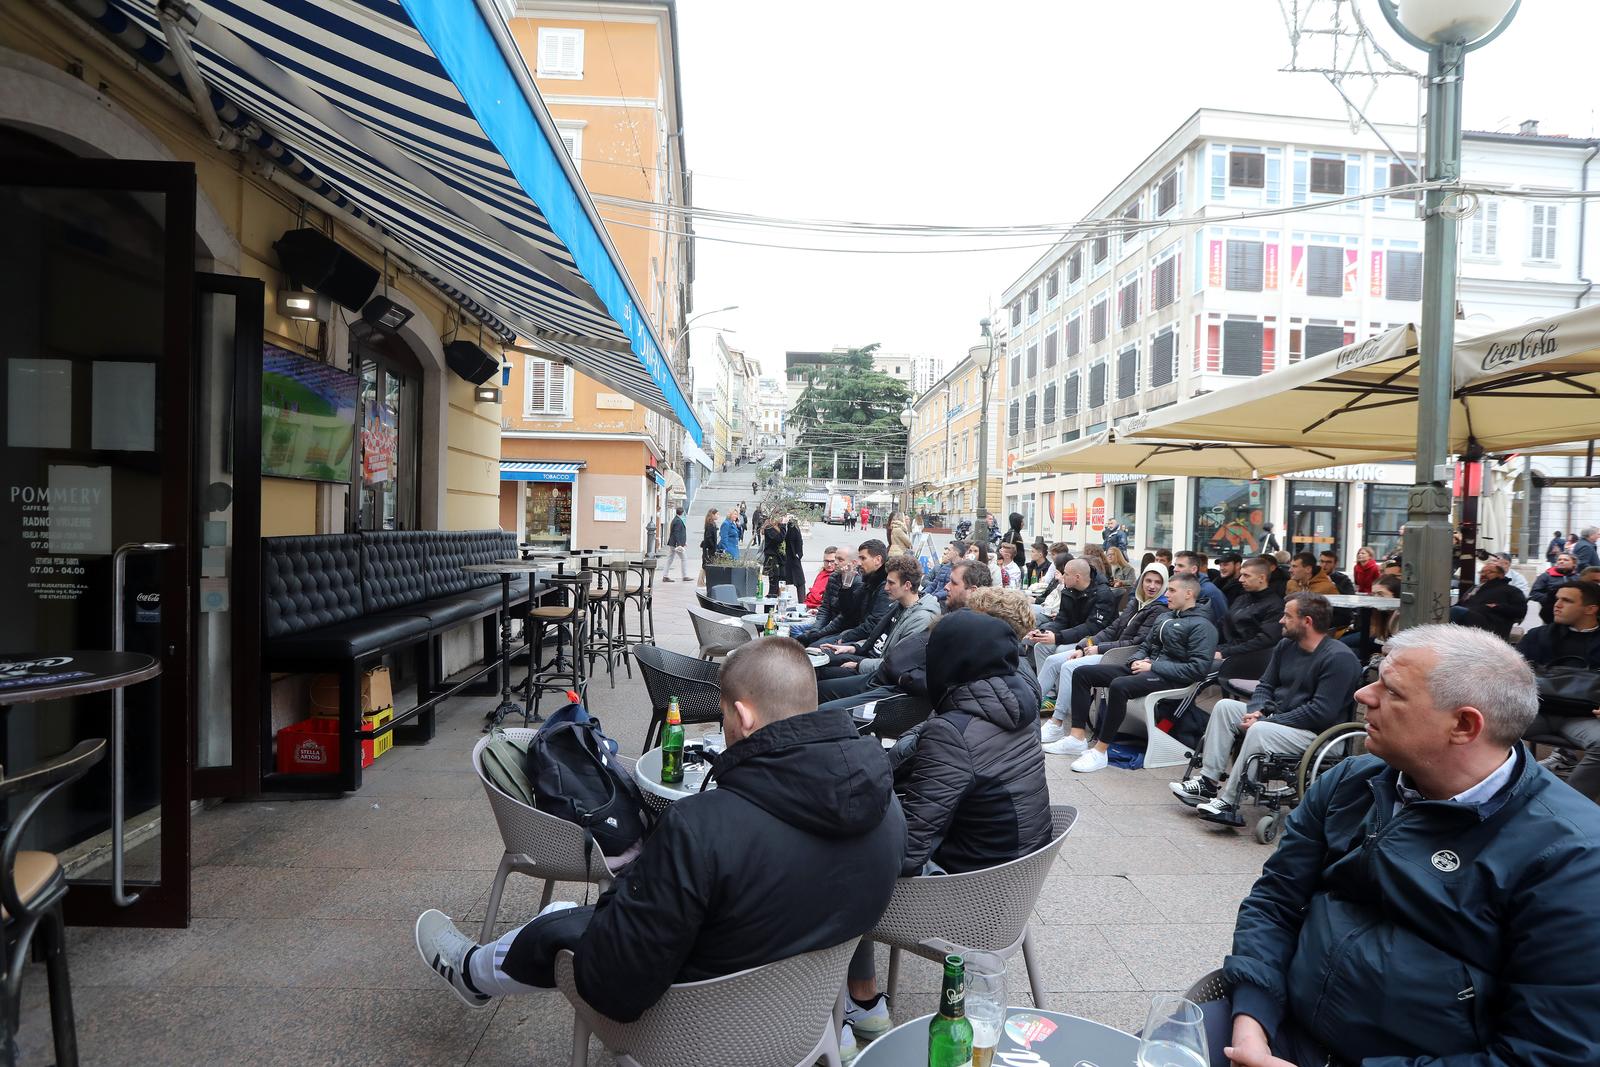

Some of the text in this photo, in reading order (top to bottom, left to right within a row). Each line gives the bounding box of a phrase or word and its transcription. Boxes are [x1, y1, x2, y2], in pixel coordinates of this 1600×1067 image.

[1347, 464, 1385, 481] KING
[10, 486, 102, 505] POMMERY
[23, 516, 51, 527] RADNO
[1092, 514, 1105, 525] KING
[30, 566, 54, 574] 07.00
[61, 567, 86, 575] 04.00
